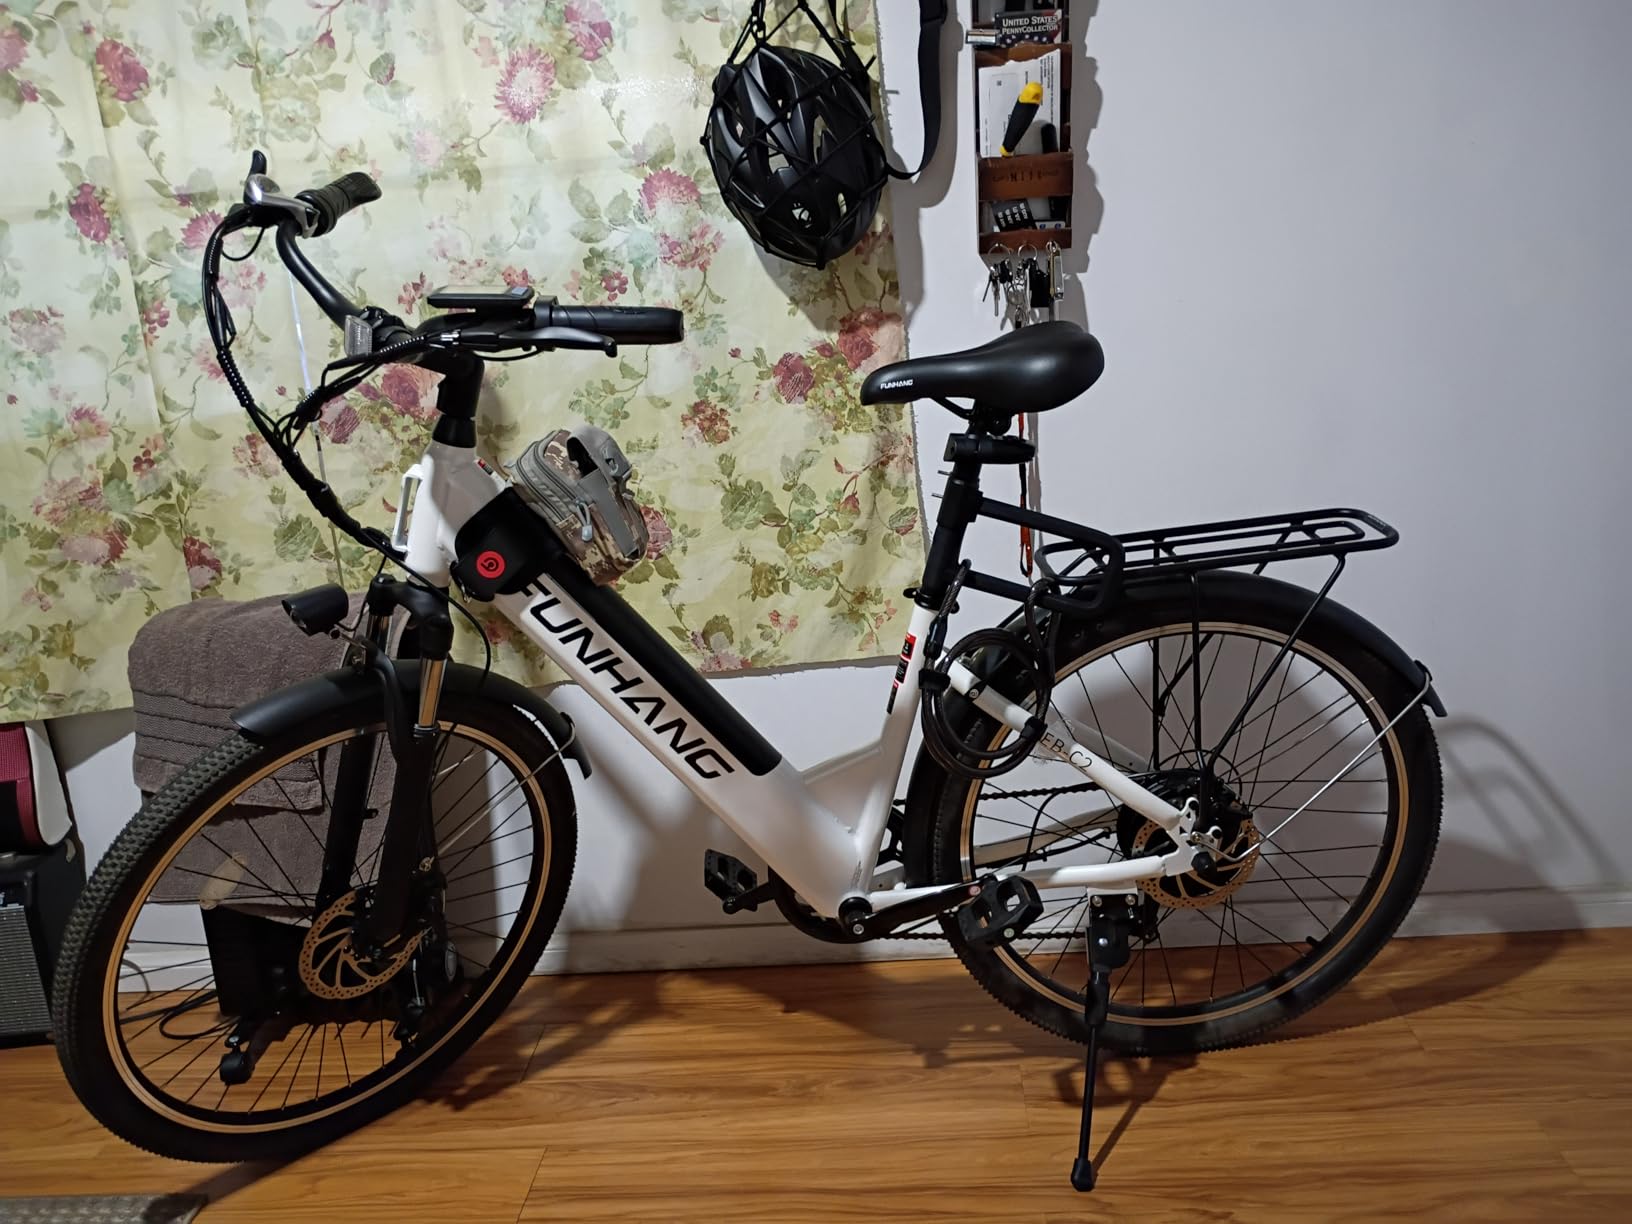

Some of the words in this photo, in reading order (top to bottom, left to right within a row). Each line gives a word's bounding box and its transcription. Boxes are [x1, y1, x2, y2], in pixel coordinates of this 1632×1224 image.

[1002, 17, 1030, 27] UNITED
[1031, 15, 1058, 25] STATES
[880, 379, 914, 390] FUNHANG
[1040, 732, 1093, 773] EB-C2
